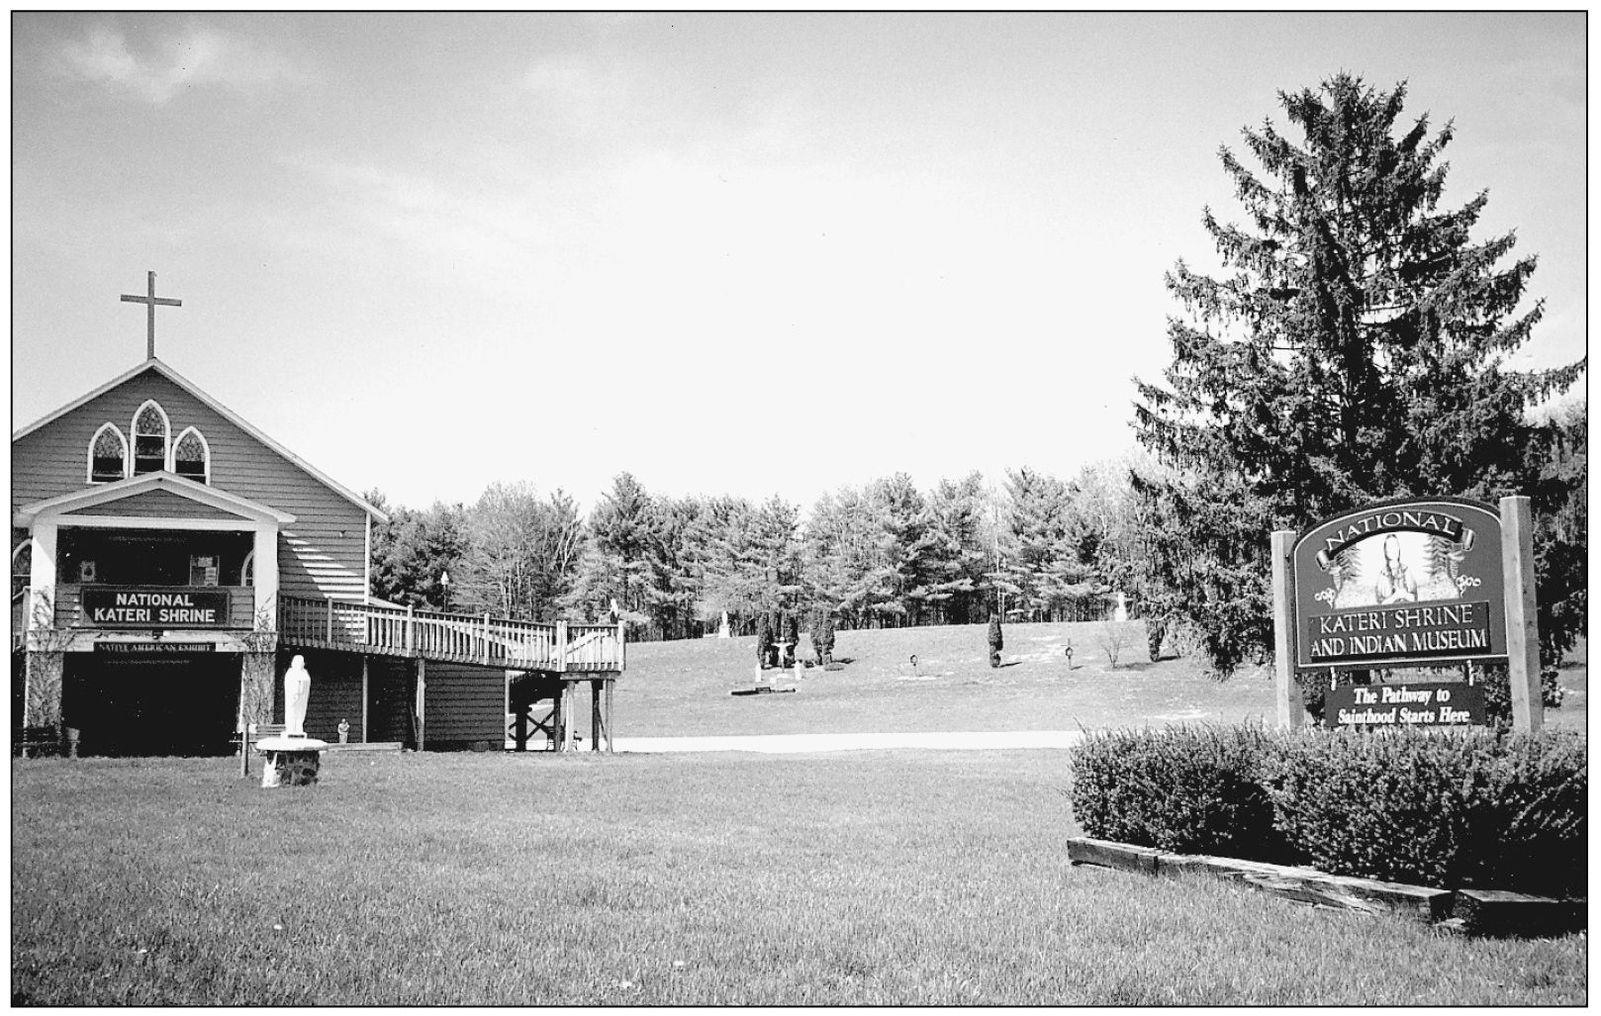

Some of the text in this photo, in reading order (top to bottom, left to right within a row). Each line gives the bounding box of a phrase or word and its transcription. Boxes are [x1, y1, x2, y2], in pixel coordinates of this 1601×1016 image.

[1326, 511, 1456, 551] NATIONAL
[116, 594, 194, 606] NATIONAL
[94, 608, 215, 623] KATERI SHRINE
[1320, 605, 1473, 634] KATERI SHRINE
[99, 643, 211, 652] NATIVE AMERICAN EXHIBIT
[1311, 629, 1487, 657] AND INDIAN MUSEUM
[1354, 687, 1450, 705] The Pathway to
[1338, 707, 1470, 724] Sainthood Starts Here
